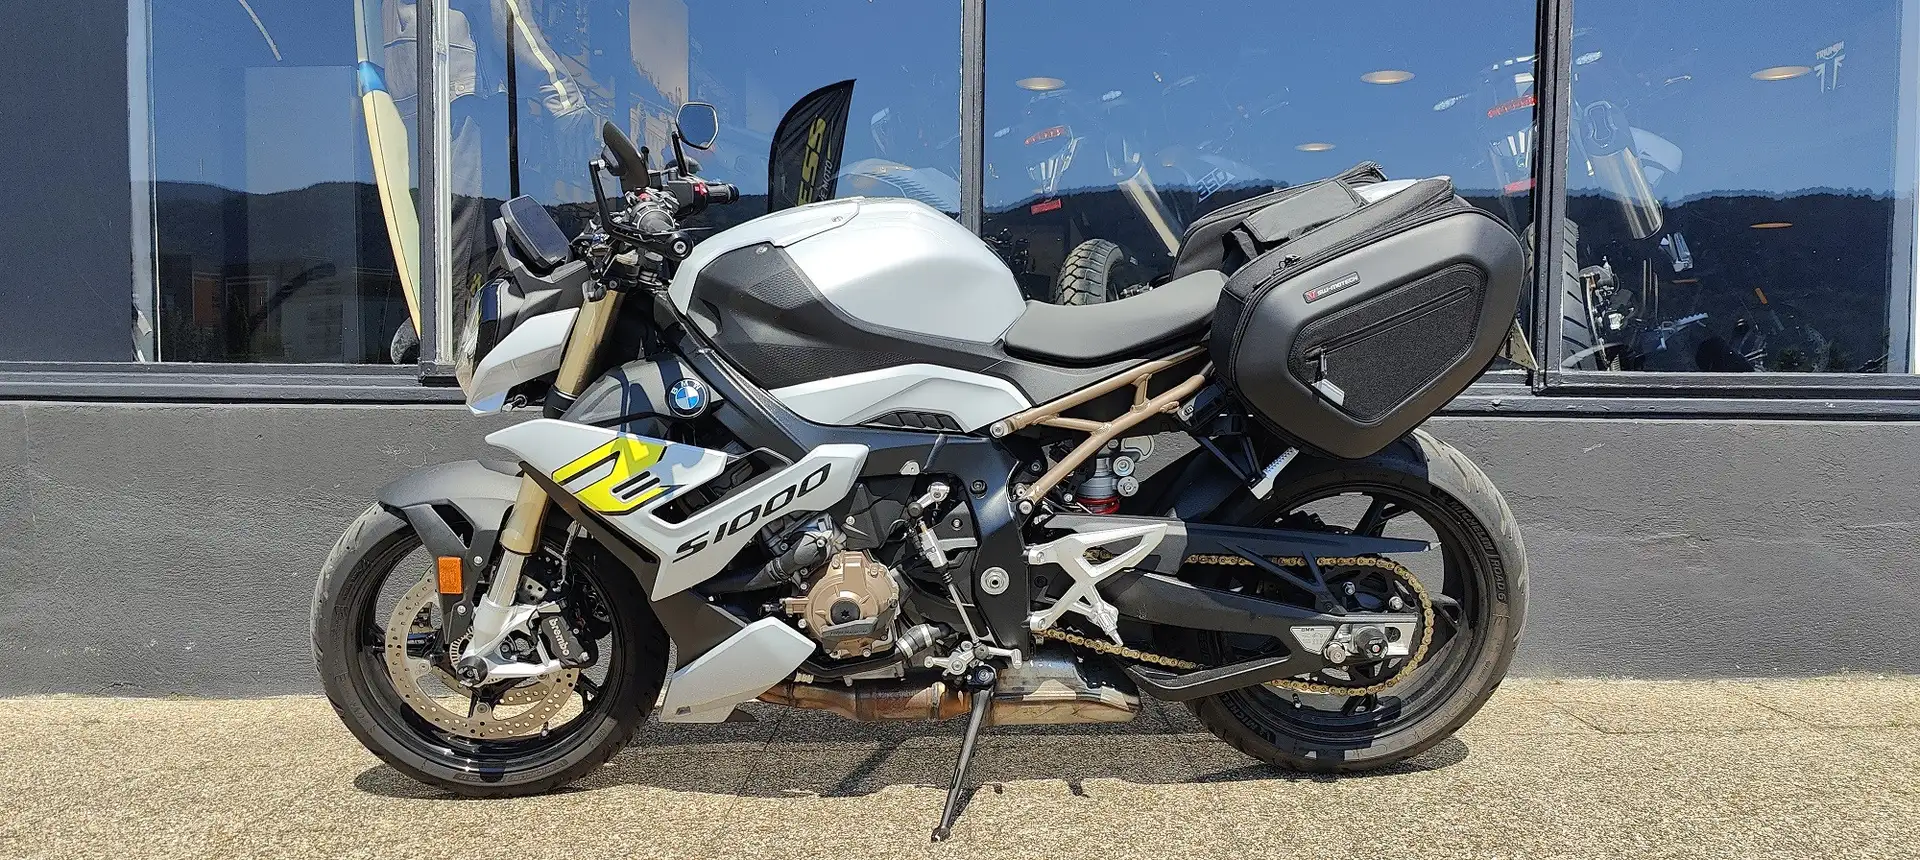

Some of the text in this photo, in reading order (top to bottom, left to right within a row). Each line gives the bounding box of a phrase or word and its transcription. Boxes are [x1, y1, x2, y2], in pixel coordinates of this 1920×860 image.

[822, 160, 833, 192] MOTO
[670, 379, 702, 395] BMW
[672, 463, 832, 563] S1000
[1447, 498, 1495, 554] MICHELIN
[1490, 558, 1506, 592] ROAD
[548, 617, 570, 656] brembo
